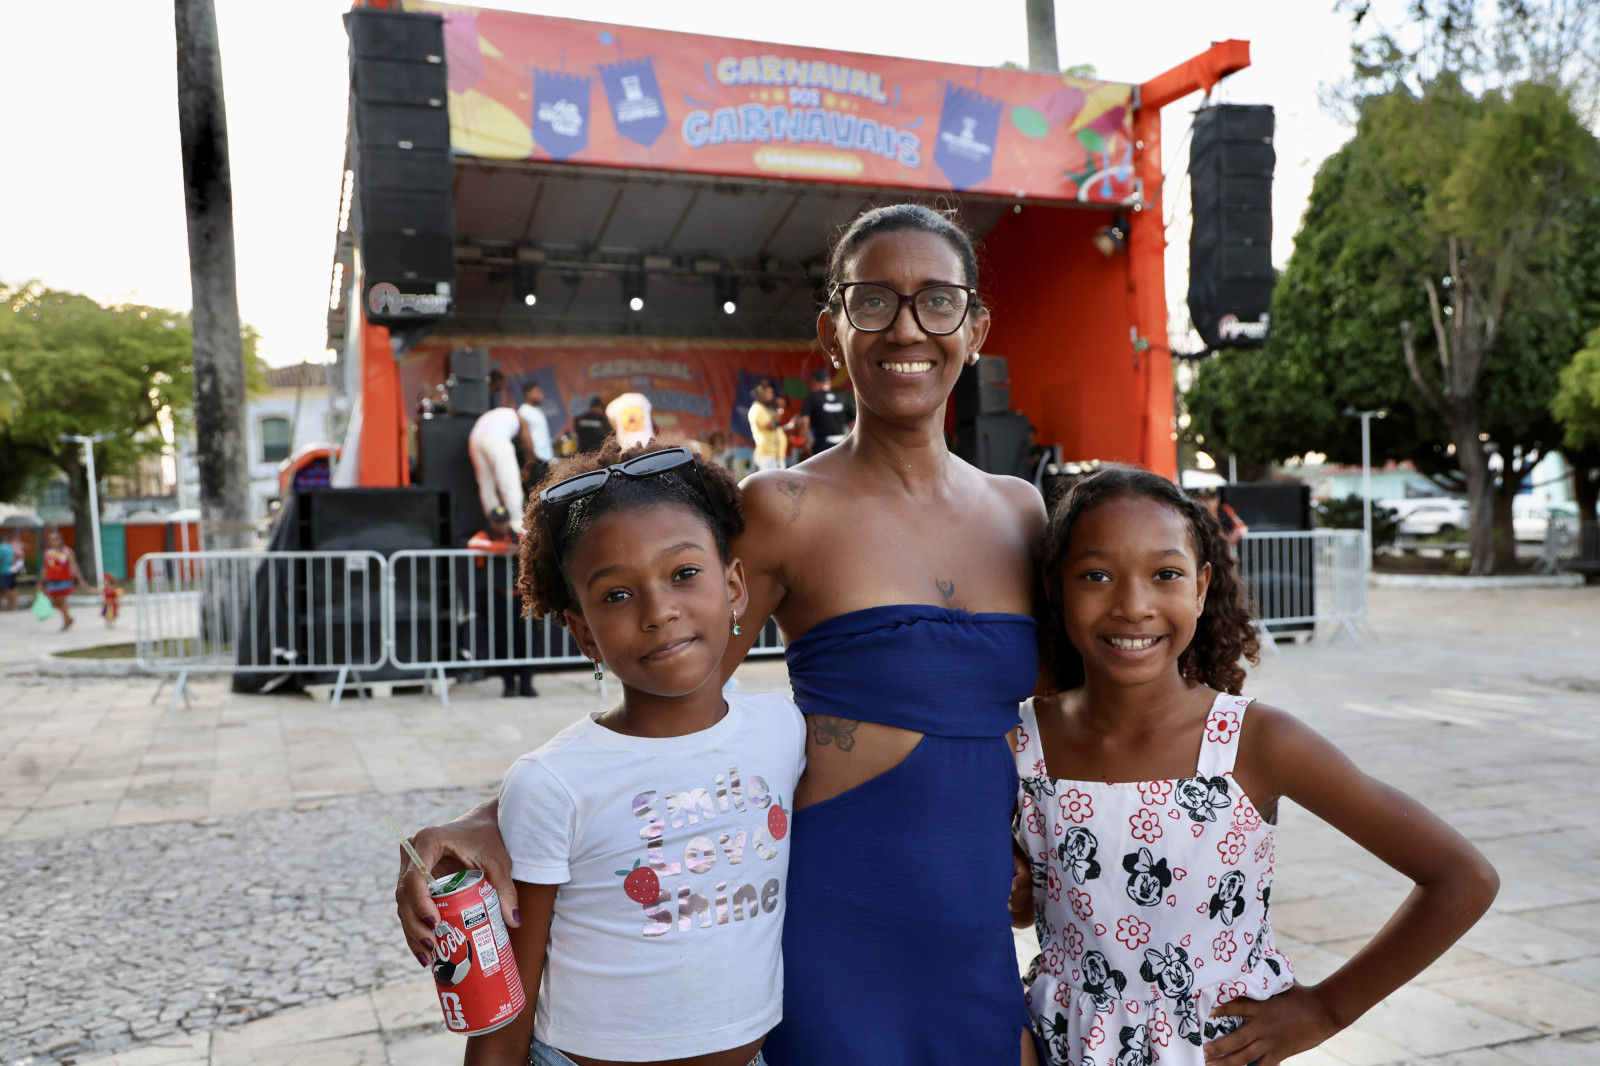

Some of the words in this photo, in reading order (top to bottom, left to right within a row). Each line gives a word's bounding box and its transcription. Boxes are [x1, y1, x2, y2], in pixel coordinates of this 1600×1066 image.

[717, 55, 888, 105] CARNAVAL
[789, 86, 821, 107] DOS
[682, 103, 921, 168] CARNAVAIS
[632, 767, 772, 840] Smile
[647, 825, 779, 878] Love
[642, 878, 780, 937] Shine
